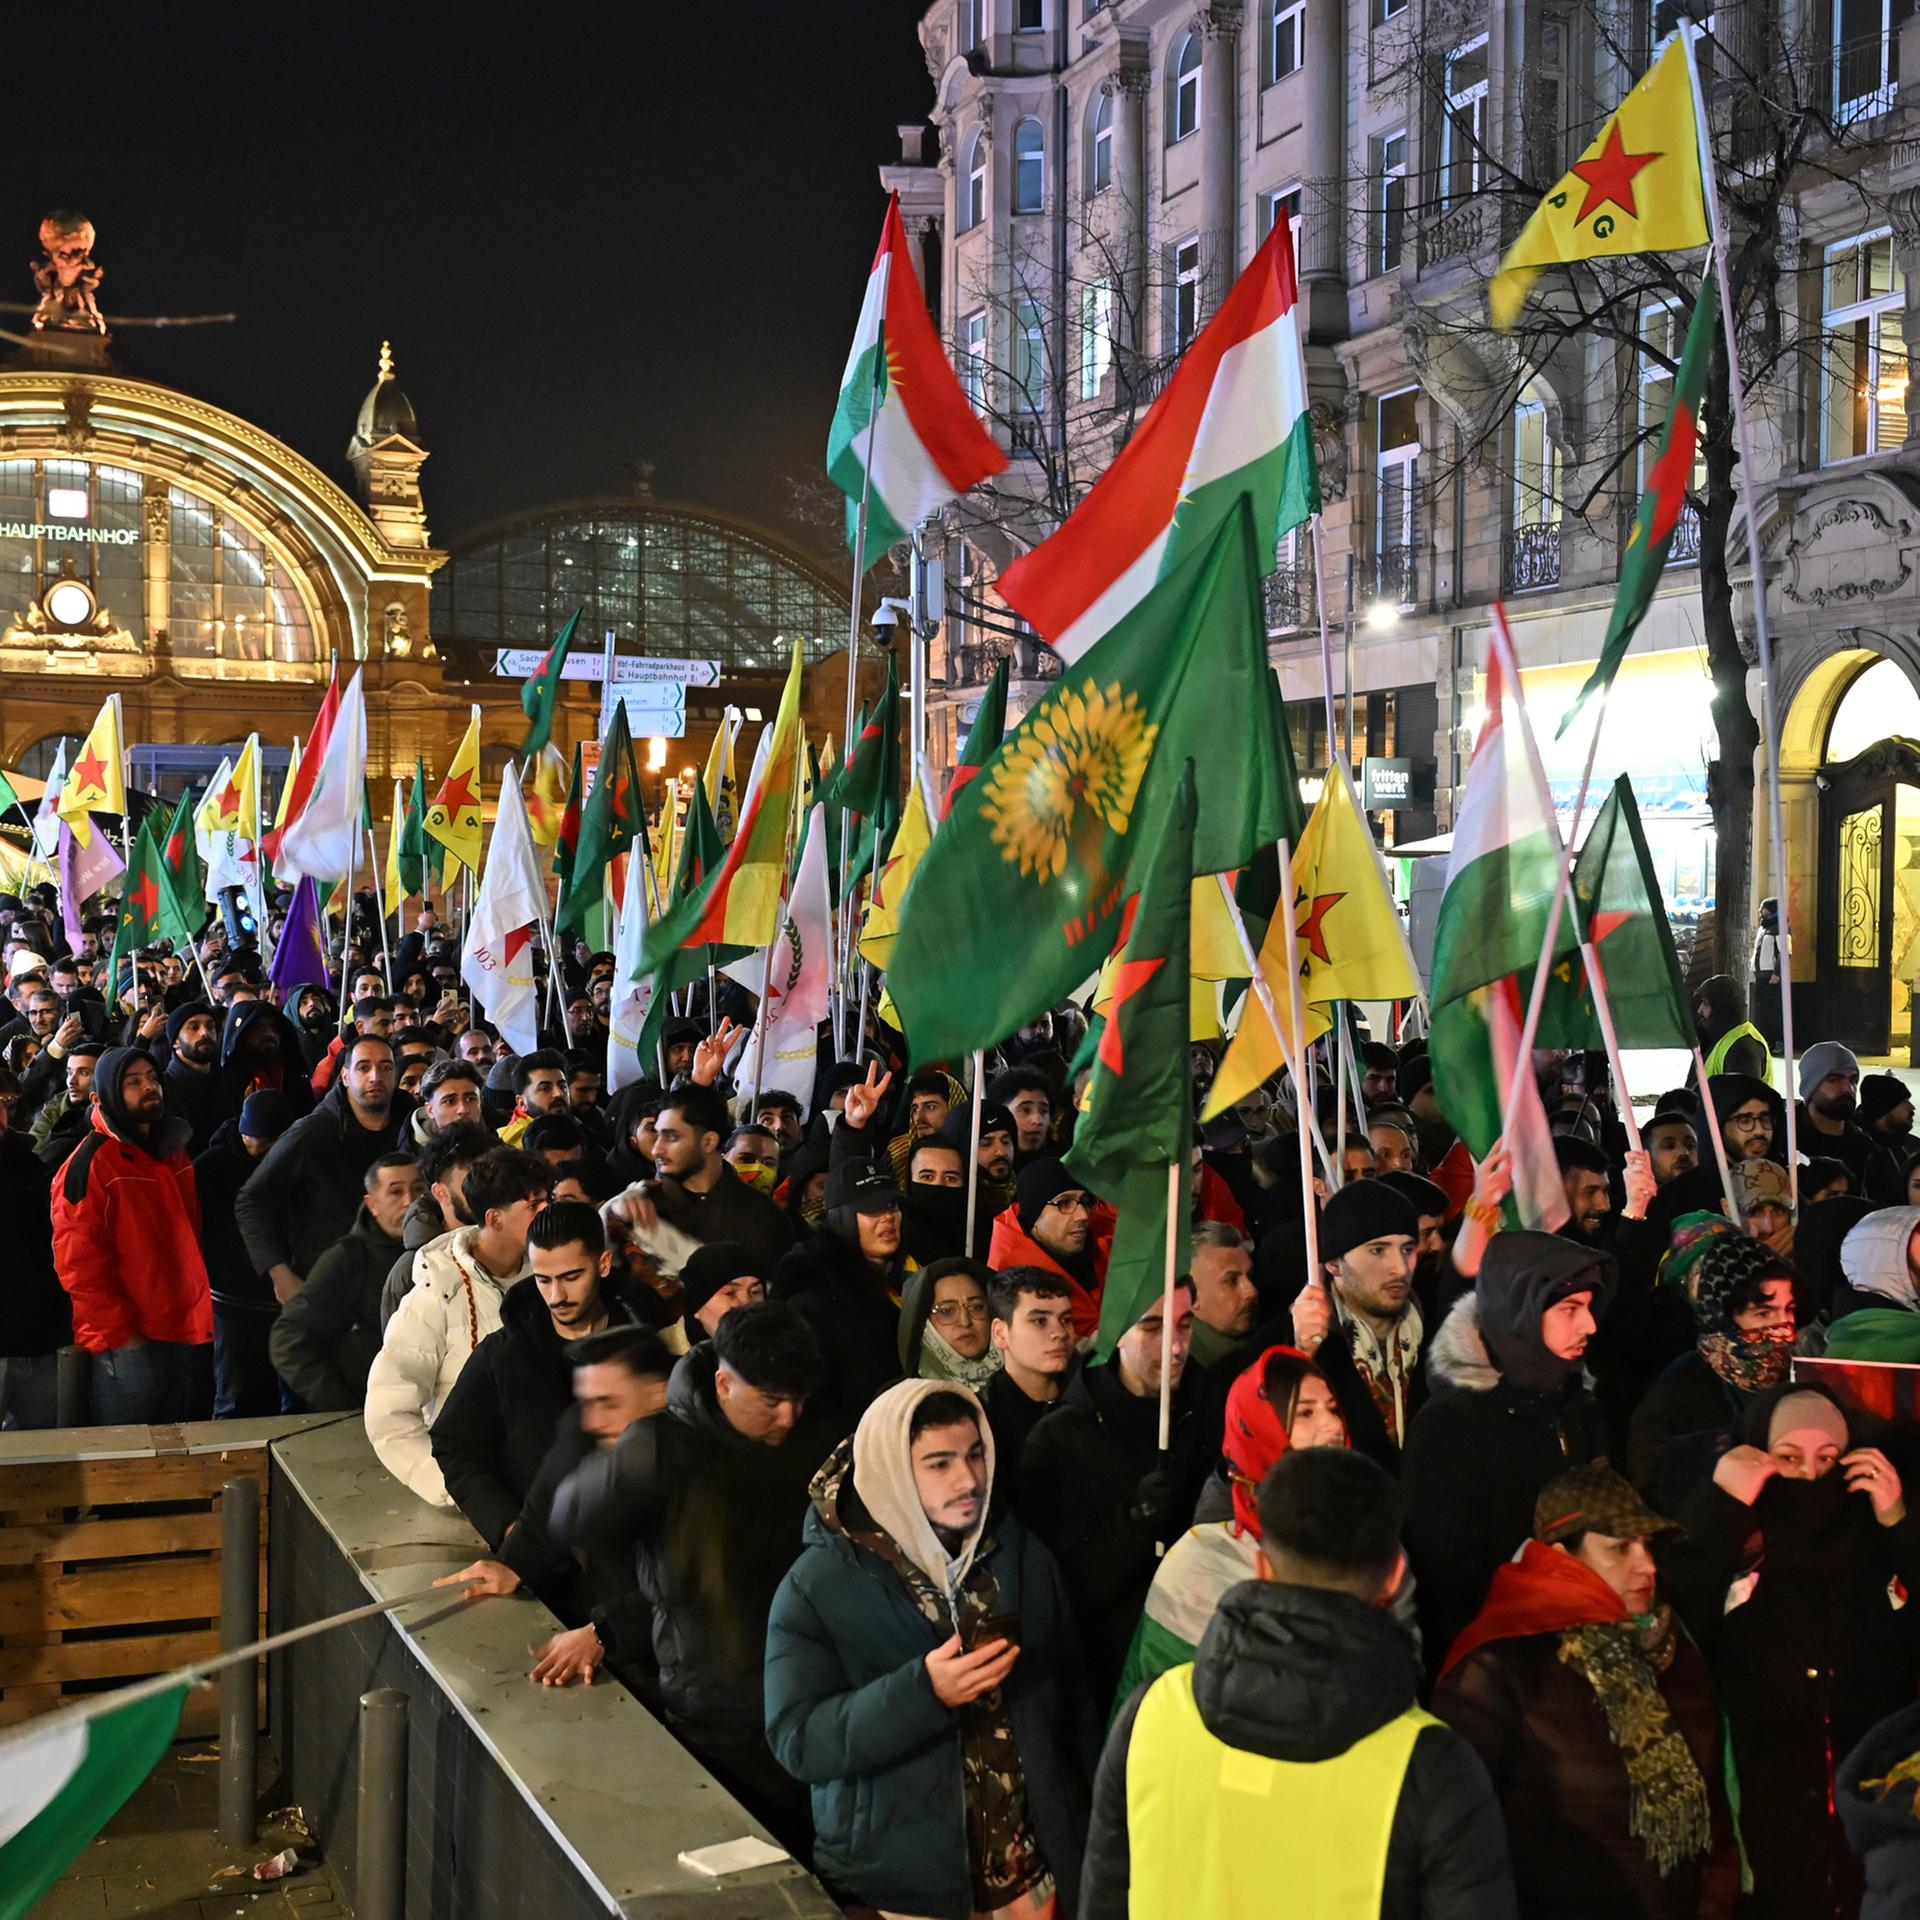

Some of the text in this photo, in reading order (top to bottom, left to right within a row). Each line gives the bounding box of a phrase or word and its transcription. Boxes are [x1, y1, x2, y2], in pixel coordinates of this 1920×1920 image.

[0, 522, 139, 545] HAUPTBAHNHOF
[628, 671, 687, 682] Hauptbahnhof
[1371, 768, 1409, 783] fritten
[1374, 781, 1406, 793] werk
